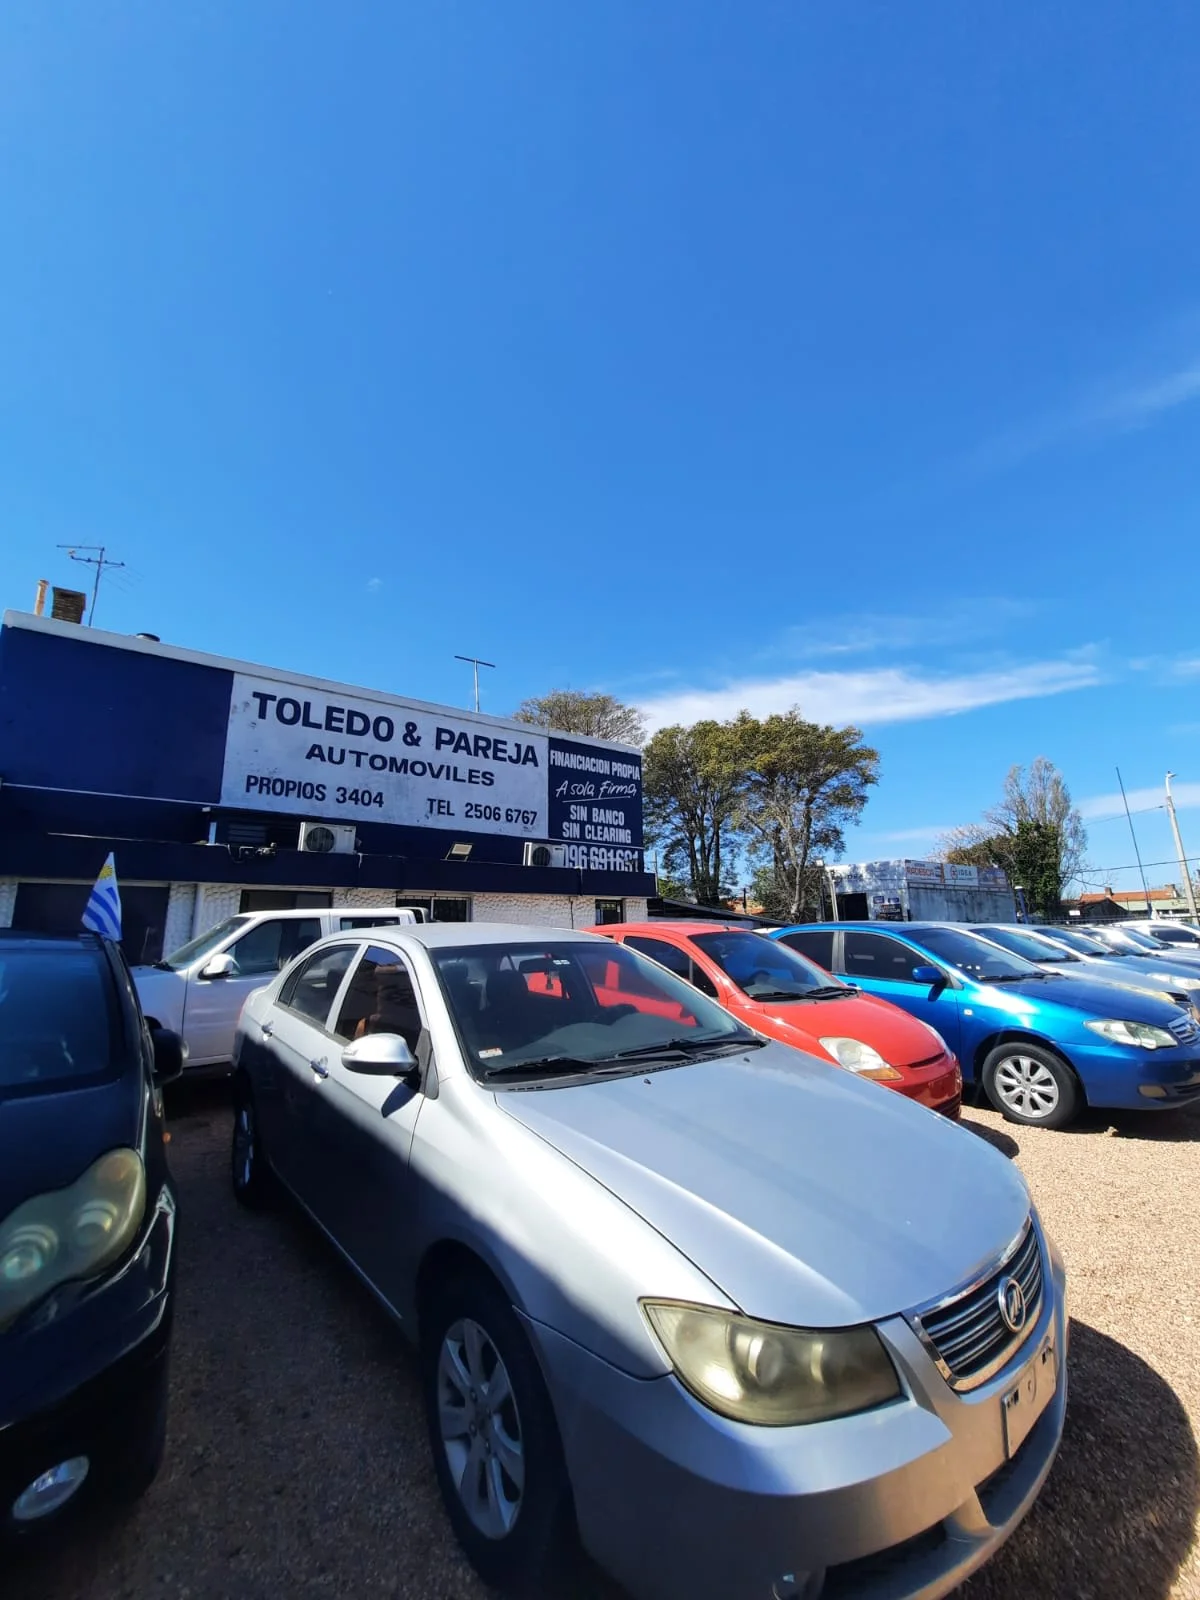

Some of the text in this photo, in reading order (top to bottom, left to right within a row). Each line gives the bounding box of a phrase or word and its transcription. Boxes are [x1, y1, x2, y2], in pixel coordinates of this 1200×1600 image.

[252, 691, 539, 767] TOLEDO & PAREJA
[305, 744, 495, 786] AUTOMOVILES
[550, 750, 640, 780] FINANCIACION PROPIA
[245, 775, 384, 808] PROPIOS 3404
[556, 780, 568, 797] A
[570, 781, 595, 797] sola
[427, 798, 538, 825] TEL 2506 6767
[570, 804, 625, 826] SIN BANCO
[562, 822, 632, 844] SIN CLEARING
